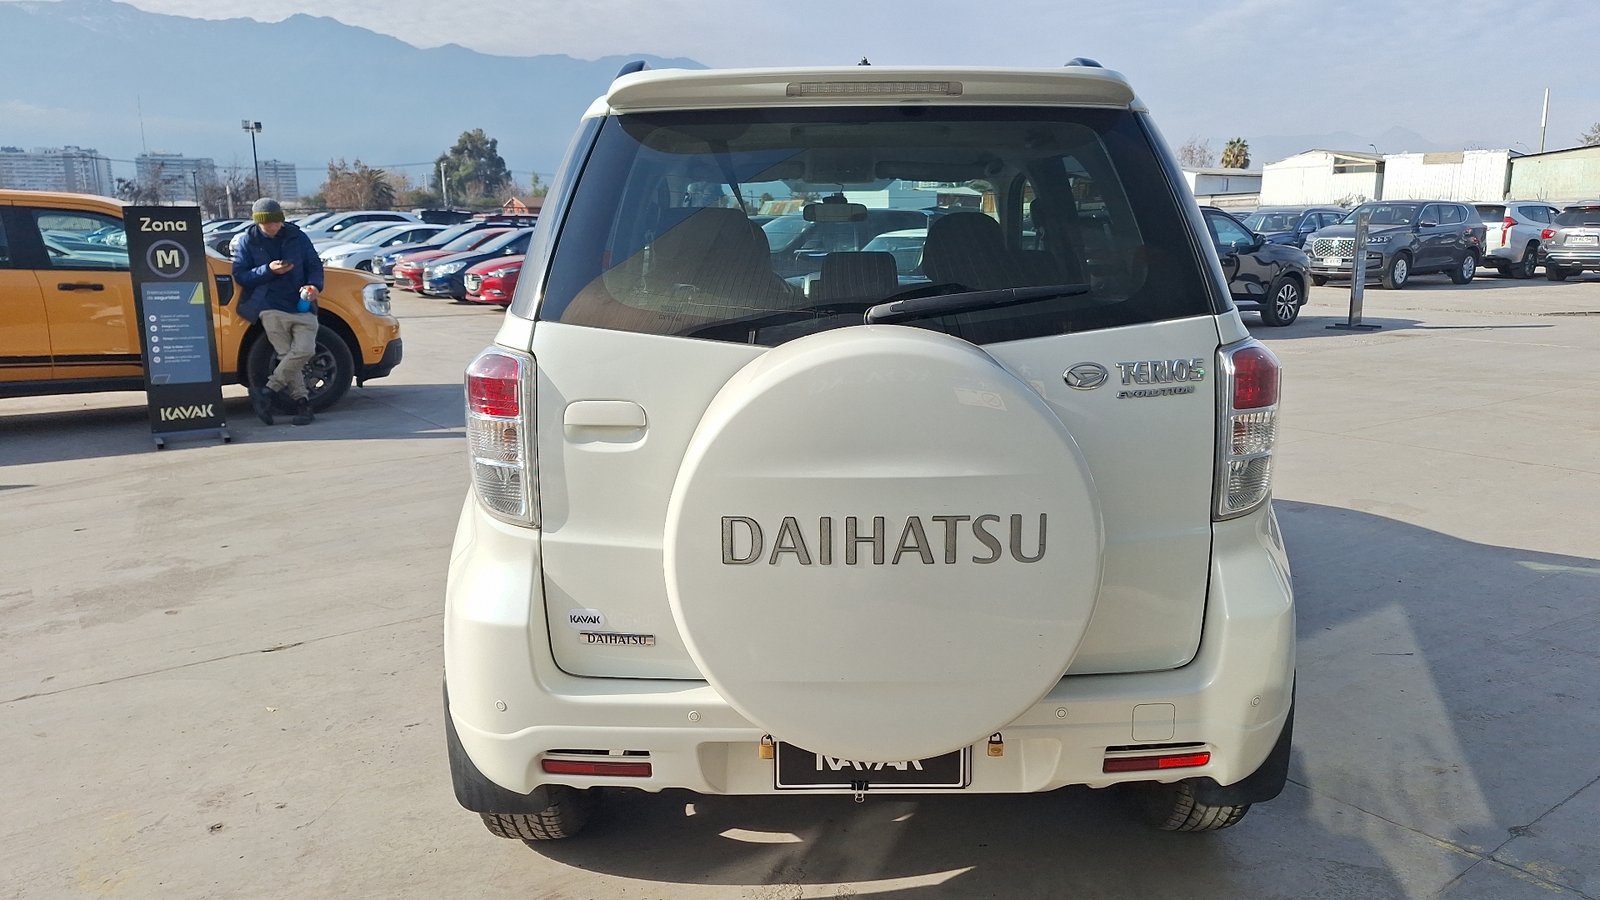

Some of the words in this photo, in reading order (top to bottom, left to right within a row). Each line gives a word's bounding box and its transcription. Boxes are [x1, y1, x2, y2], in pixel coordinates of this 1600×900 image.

[140, 217, 187, 232] Zona
[156, 249, 180, 268] M
[1115, 358, 1205, 385] TERIOS
[1116, 385, 1195, 399] EVOLUTION
[160, 404, 215, 421] KAVAK
[721, 513, 1047, 565] DAIHATSU
[569, 615, 601, 624] KAVAK
[587, 633, 647, 645] DAIHATSU
